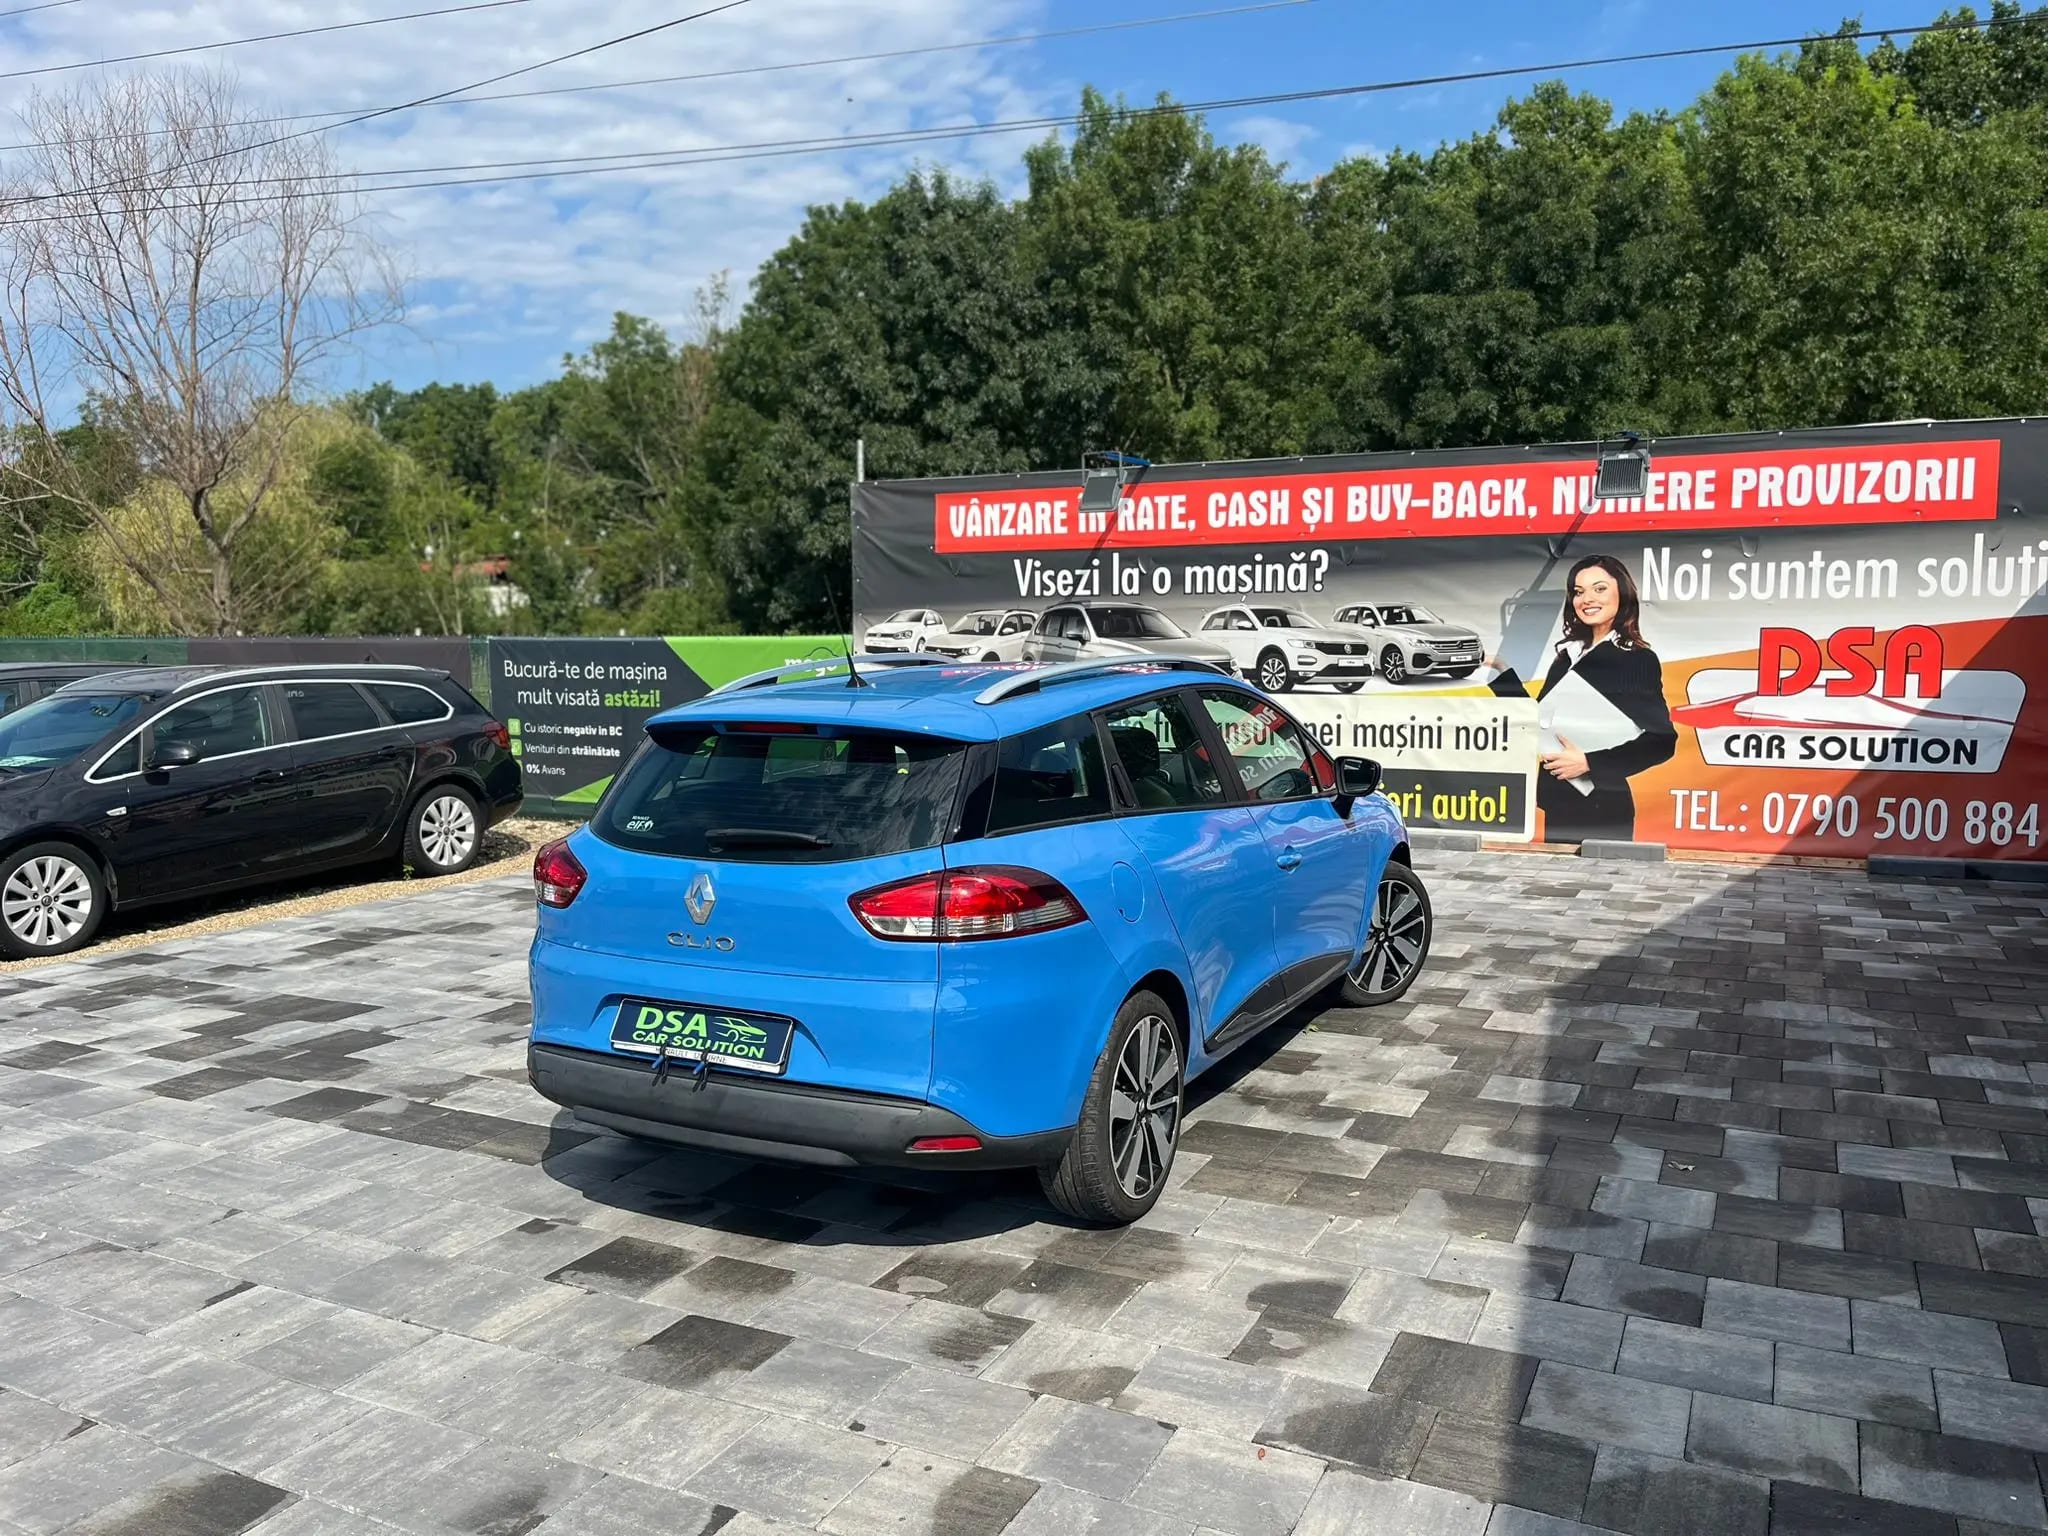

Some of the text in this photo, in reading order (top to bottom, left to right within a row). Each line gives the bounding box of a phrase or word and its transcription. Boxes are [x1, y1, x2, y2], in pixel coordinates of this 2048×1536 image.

[949, 497, 1068, 538] VÂNZARE
[1116, 494, 1197, 532] RATE,
[1207, 488, 1290, 528] CASH
[1302, 486, 1333, 533] ȘI
[1731, 457, 1976, 509] PROVIZORII
[1013, 557, 1100, 598] Visezi
[1112, 552, 1140, 596] la
[1152, 566, 1172, 595] o
[1641, 547, 1713, 601] Noi
[1728, 550, 1899, 601] suntem
[504, 660, 667, 684] Bucură-te de mașina
[1757, 624, 1945, 699] DSA
[517, 688, 661, 708] mult visată astăzi!
[524, 722, 537, 733] Cu
[537, 723, 562, 734] istoric
[563, 725, 597, 737] negativ
[609, 727, 623, 736] BC
[1353, 715, 1443, 757] mașini
[1455, 715, 1509, 752] noi!
[525, 744, 555, 755] Venituri
[557, 745, 570, 755] din
[1723, 733, 1978, 766] CAR SOLUTION
[526, 764, 566, 776] 0% Avans
[1432, 786, 1508, 824] auto!
[1669, 789, 2041, 848] TEL.: 0790 500 884
[667, 931, 736, 952] CLIO
[635, 1006, 708, 1038] DSA
[632, 1030, 765, 1060] CAR SOLUTION
